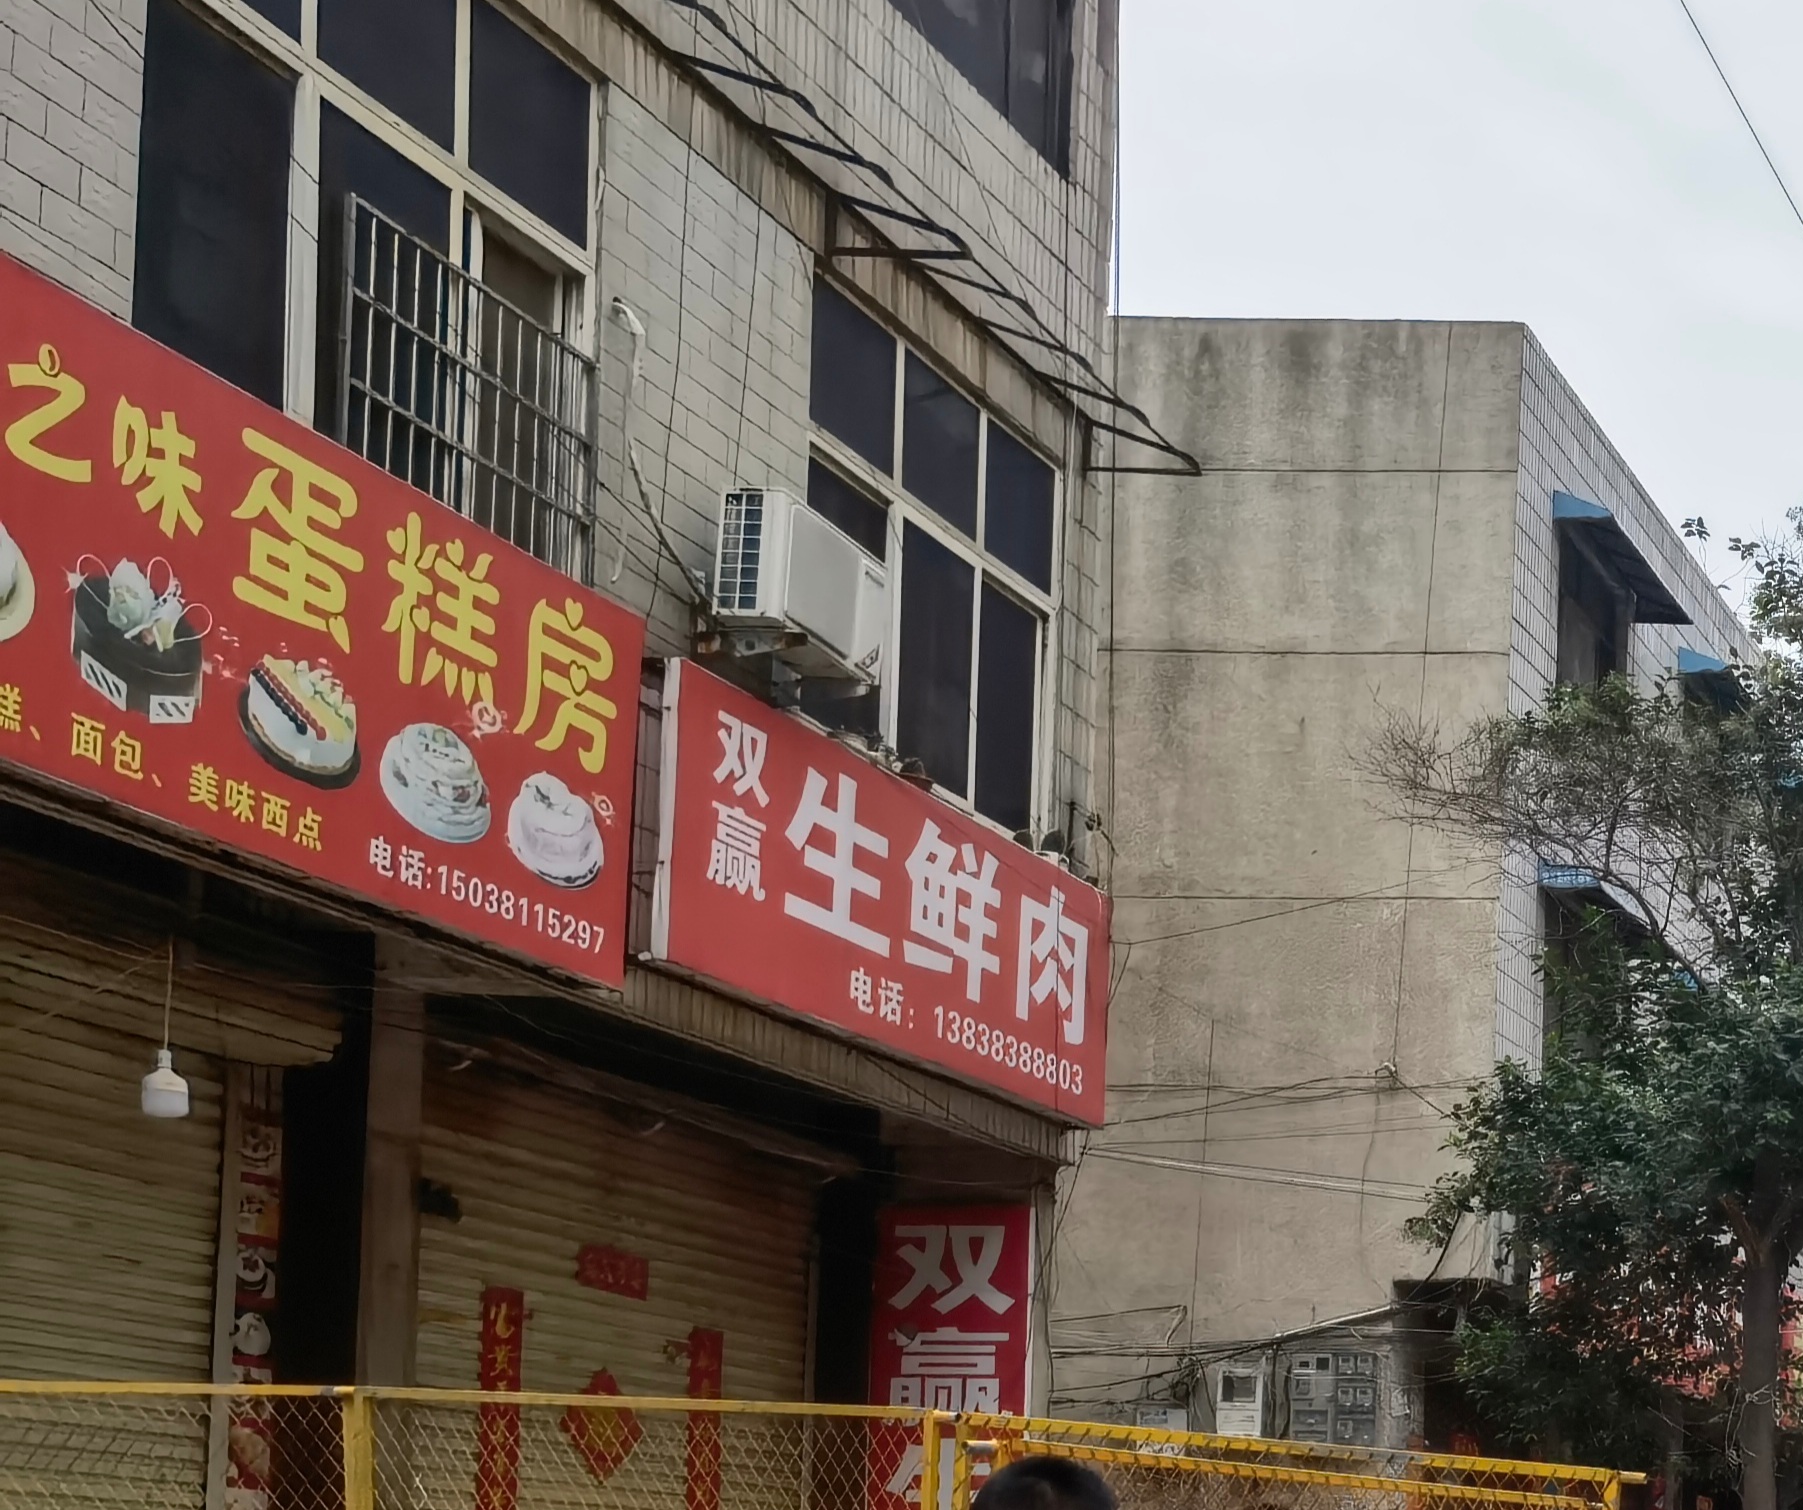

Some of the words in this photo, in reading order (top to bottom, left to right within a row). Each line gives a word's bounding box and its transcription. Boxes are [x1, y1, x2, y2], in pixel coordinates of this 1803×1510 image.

[5, 343, 618, 774] 之味蛋糕房
[706, 709, 769, 902] 双赢
[784, 765, 1089, 1046] 生鲜肉
